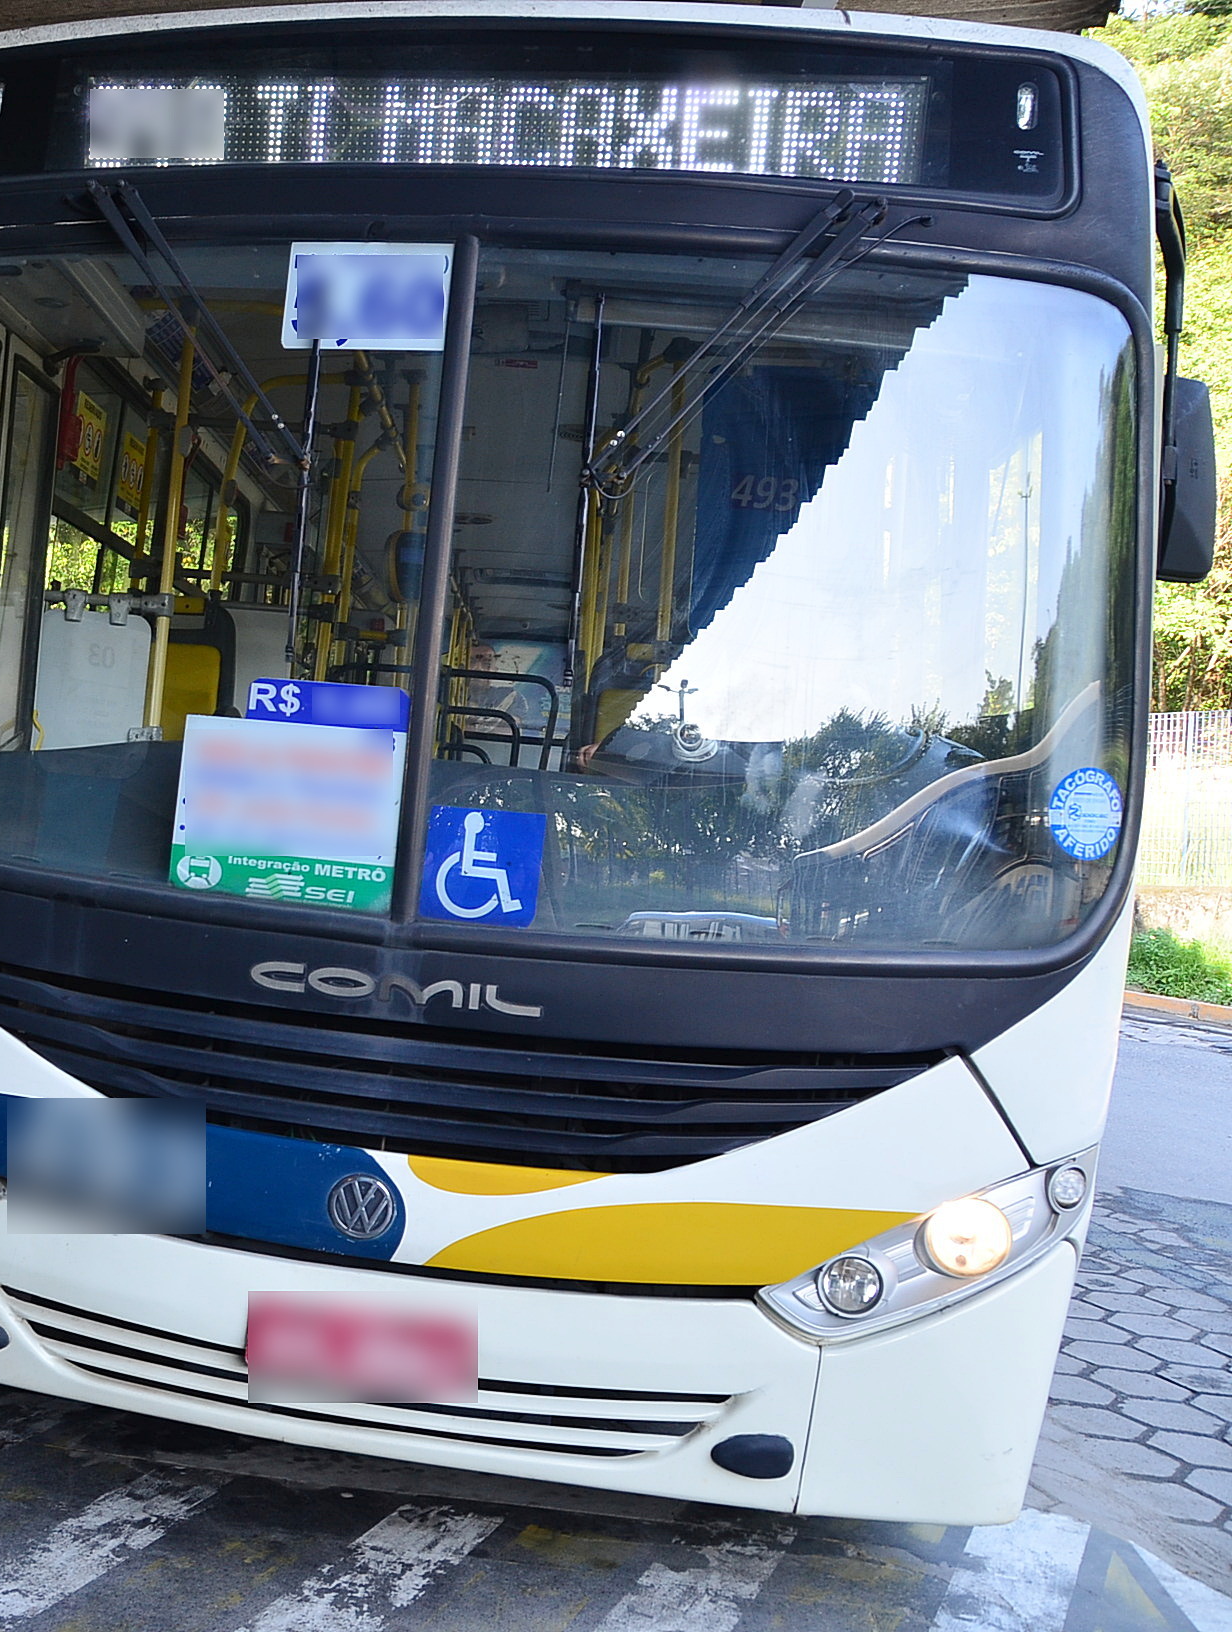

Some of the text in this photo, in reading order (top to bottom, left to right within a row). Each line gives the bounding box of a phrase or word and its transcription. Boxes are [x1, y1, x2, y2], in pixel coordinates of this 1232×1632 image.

[257, 84, 335, 162] TI
[383, 84, 906, 182] MACAXEIRA
[731, 474, 799, 512] 493
[1052, 770, 1122, 811] TACÓGRAFO
[1055, 828, 1116, 858] AFERIDO
[228, 856, 387, 882] Integração METRÔ
[304, 887, 355, 903] SEI
[250, 961, 543, 1018] COMIL
